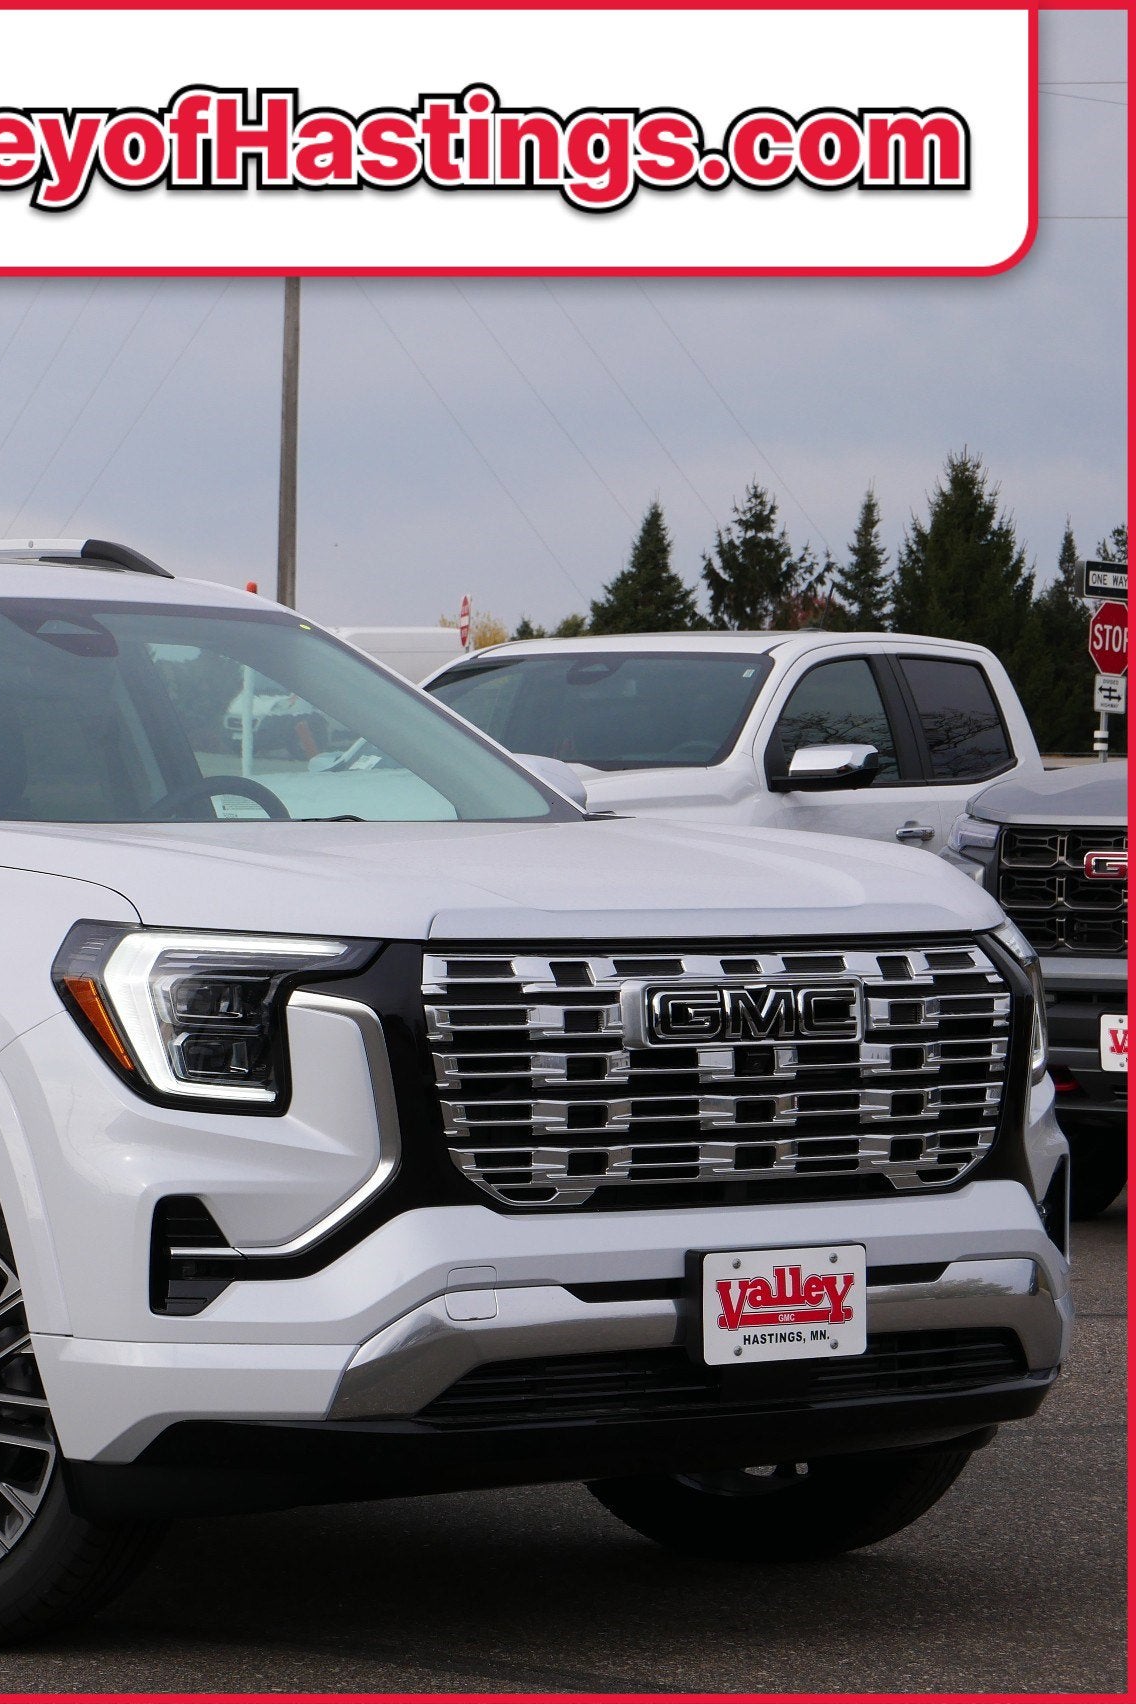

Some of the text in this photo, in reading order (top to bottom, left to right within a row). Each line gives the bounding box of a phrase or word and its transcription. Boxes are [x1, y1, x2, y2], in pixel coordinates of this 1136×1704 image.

[1091, 573, 1128, 587] ONE WAY
[652, 987, 858, 1039] GMC
[778, 1313, 796, 1323] GMC
[743, 1329, 830, 1346] HASTINGS, MN.
